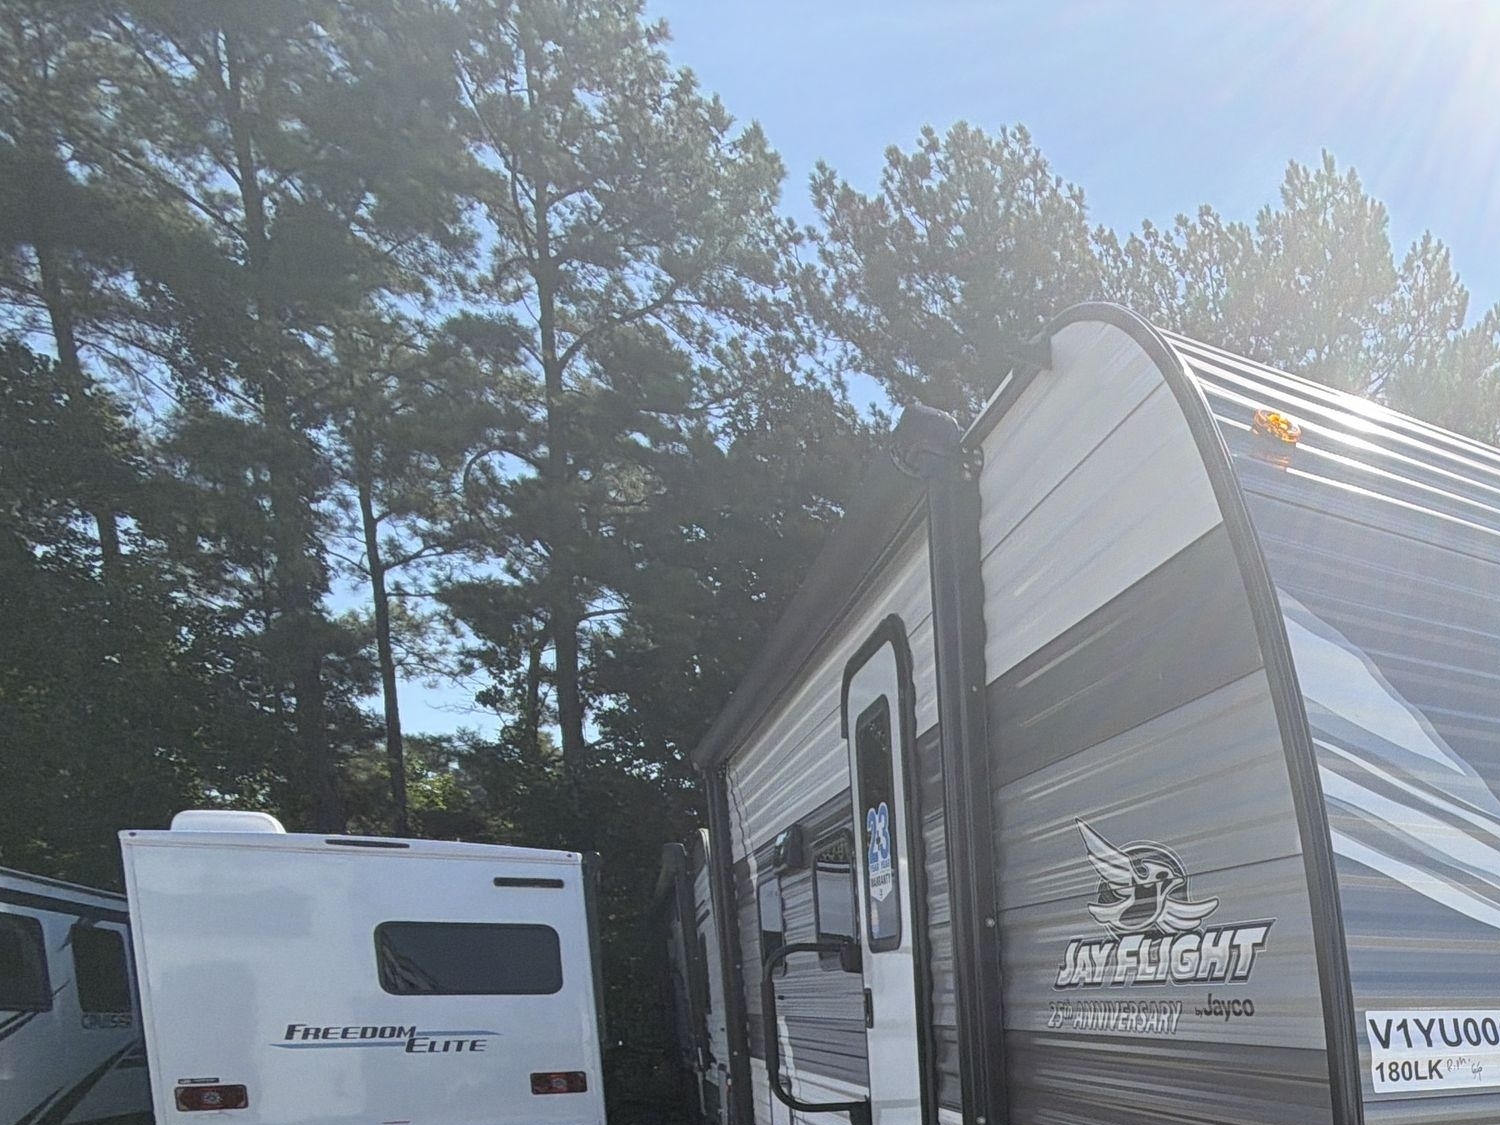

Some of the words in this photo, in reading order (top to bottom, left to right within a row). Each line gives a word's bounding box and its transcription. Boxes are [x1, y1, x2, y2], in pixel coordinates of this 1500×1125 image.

[1054, 938, 1116, 990] JAY
[1114, 918, 1276, 986] FLIGHT
[1048, 999, 1073, 1028] 25th
[1073, 999, 1182, 1034] ANNIVERSARY
[1203, 993, 1256, 1021] Jayco
[284, 1024, 416, 1040] FREEDOM
[405, 1037, 487, 1053] ELITE
[1375, 1059, 1443, 1082] 180LK
